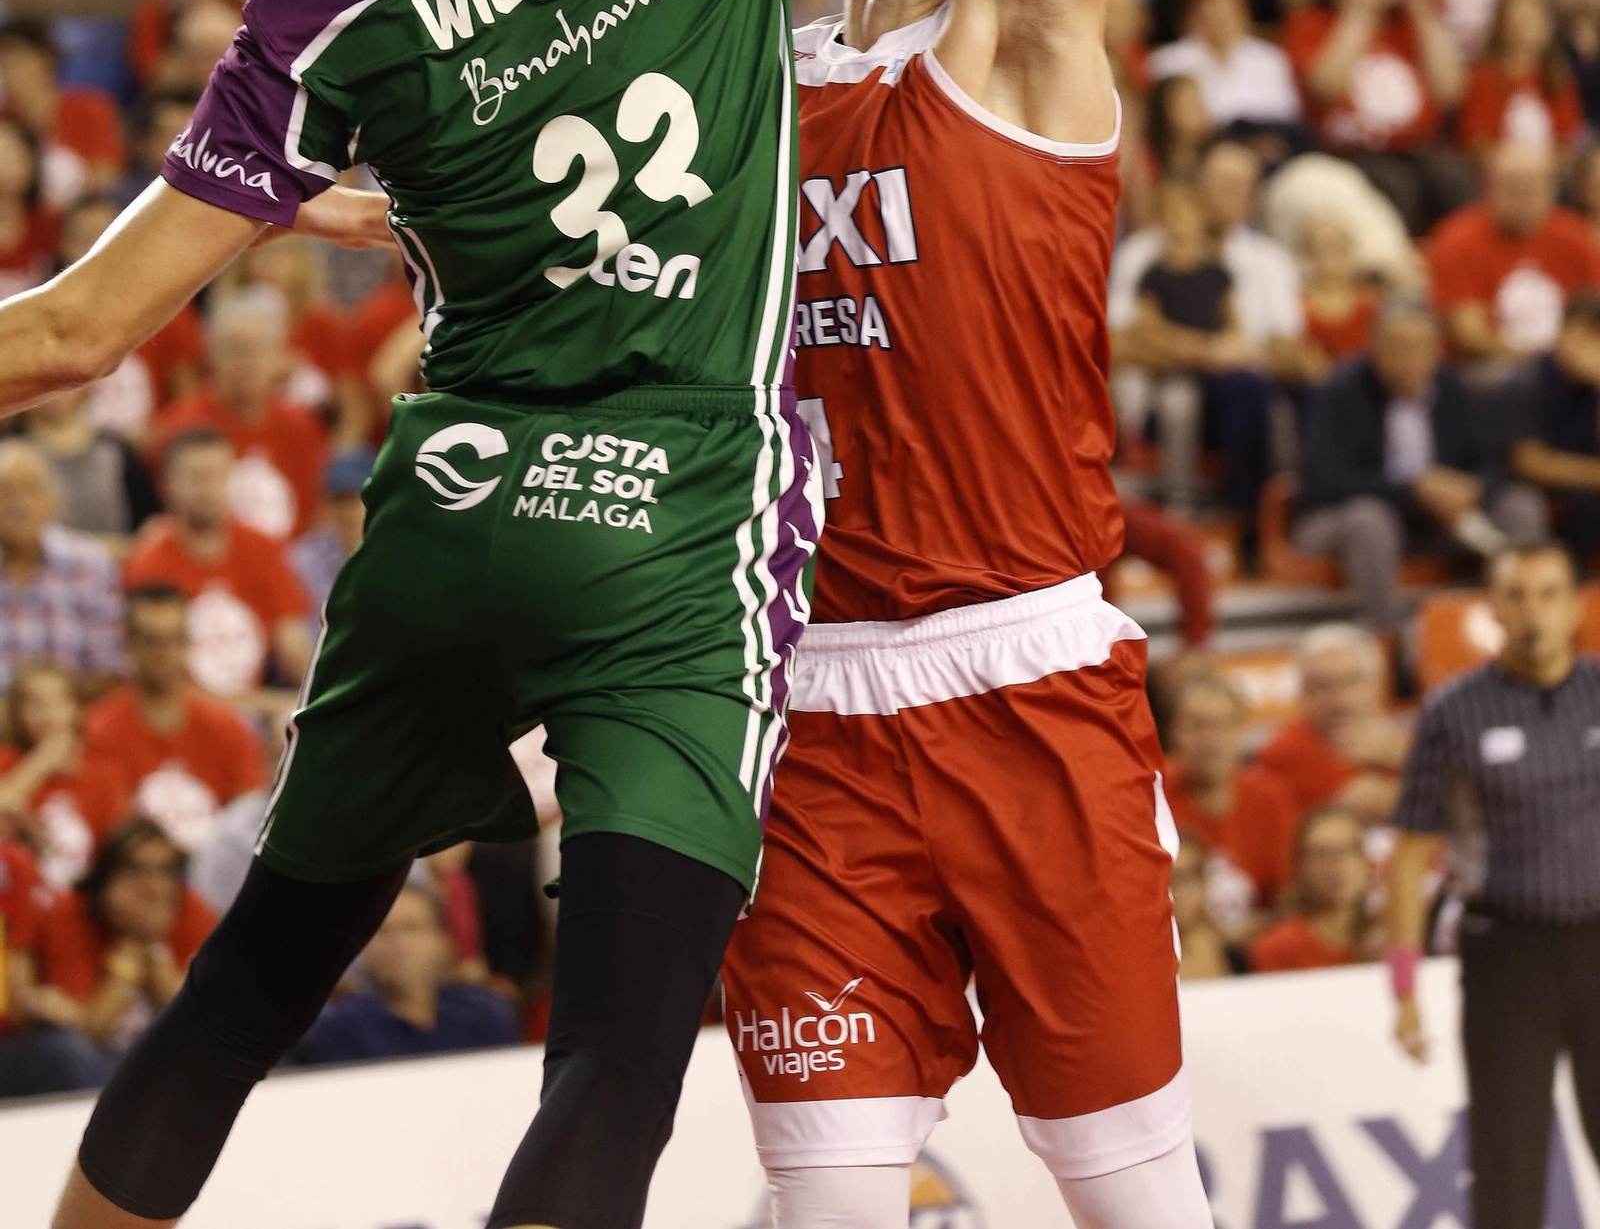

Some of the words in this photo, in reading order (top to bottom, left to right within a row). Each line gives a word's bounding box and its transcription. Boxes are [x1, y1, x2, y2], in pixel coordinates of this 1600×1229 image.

[532, 72, 715, 290] 32
[798, 167, 918, 275] XI
[541, 432, 670, 475] COSTA
[522, 464, 583, 491] DEL
[589, 469, 659, 505] SOL
[512, 490, 653, 535] MÁLAGA
